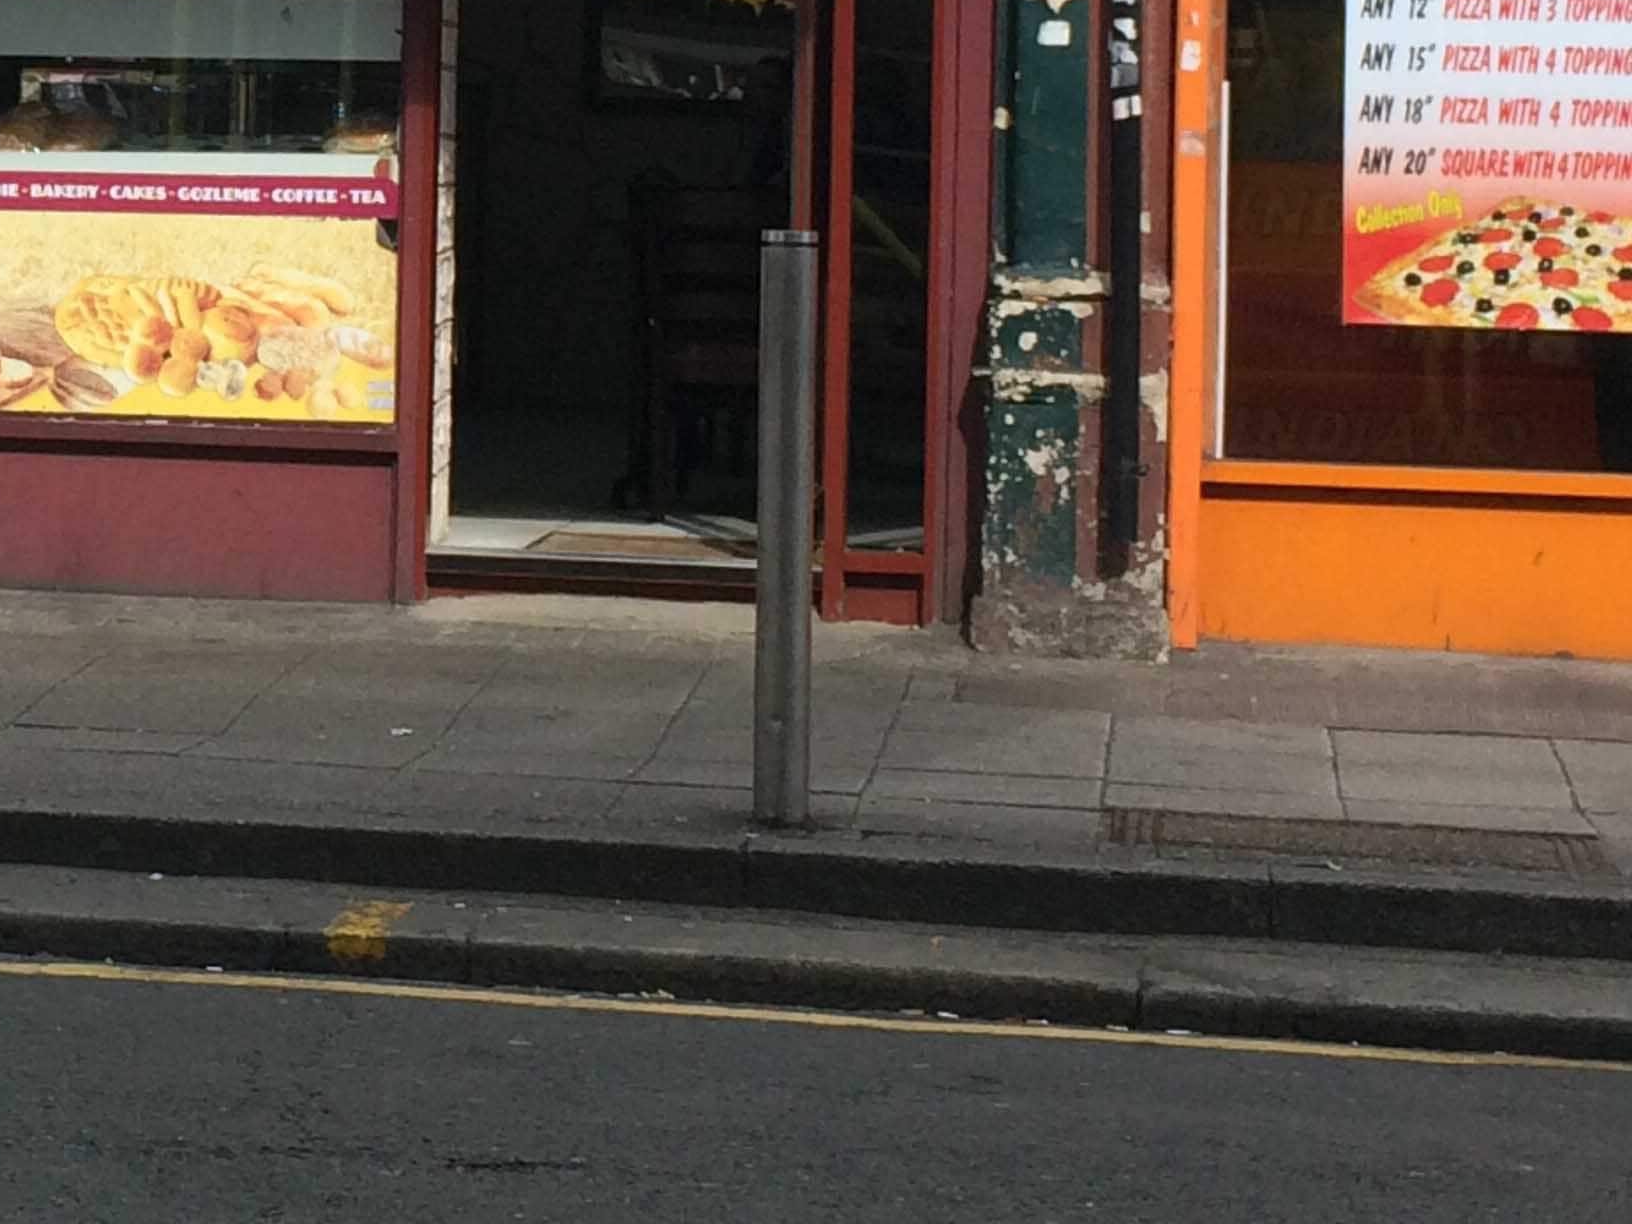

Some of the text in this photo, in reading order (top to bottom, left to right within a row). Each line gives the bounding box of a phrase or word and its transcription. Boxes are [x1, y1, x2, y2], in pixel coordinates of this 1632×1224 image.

[1361, 44, 1395, 71] ANY
[1442, 45, 1491, 73] PIZZA
[1498, 45, 1540, 73] WITH
[1545, 48, 1556, 73] 4
[1359, 96, 1394, 123] ANY
[1440, 97, 1489, 124] PIZZA
[1499, 98, 1541, 125] WITH
[1549, 101, 1561, 126] 4
[1358, 147, 1394, 175] ANY
[1441, 148, 1509, 177] SQUARE
[1513, 151, 1555, 177] WITH
[1557, 154, 1568, 179] 4
[30, 183, 99, 199] BAKERY
[109, 185, 167, 201] CAKES
[271, 188, 338, 204] COFFEE
[349, 189, 386, 205] TEA
